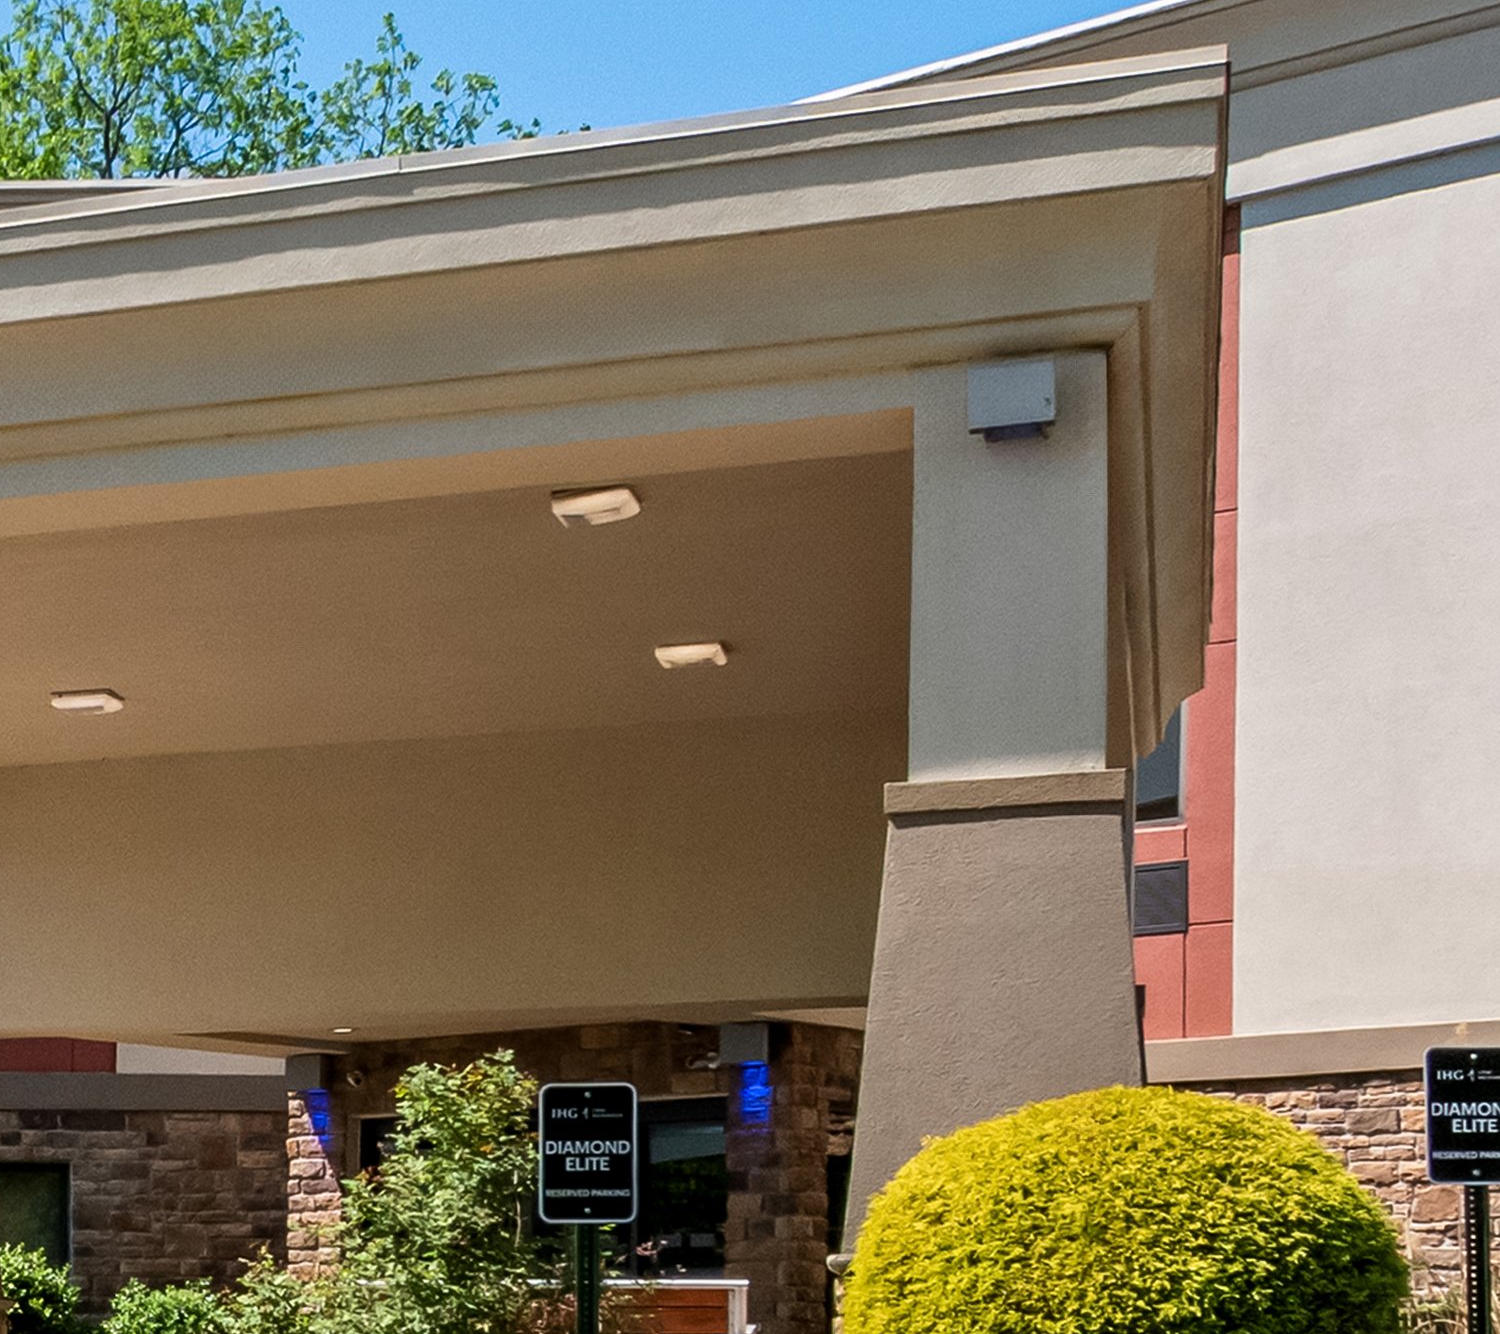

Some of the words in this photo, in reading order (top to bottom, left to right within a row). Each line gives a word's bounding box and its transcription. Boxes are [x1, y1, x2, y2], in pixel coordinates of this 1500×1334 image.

[1436, 1069, 1464, 1081] IHG
[551, 1108, 578, 1119] IHG
[1452, 1119, 1499, 1133] ELITE
[545, 1140, 631, 1155] DIAMOND
[1432, 1151, 1478, 1160] RESERVED
[565, 1157, 610, 1171] ELITE
[545, 1189, 590, 1198] RESERVED
[591, 1189, 630, 1198] PARKING
